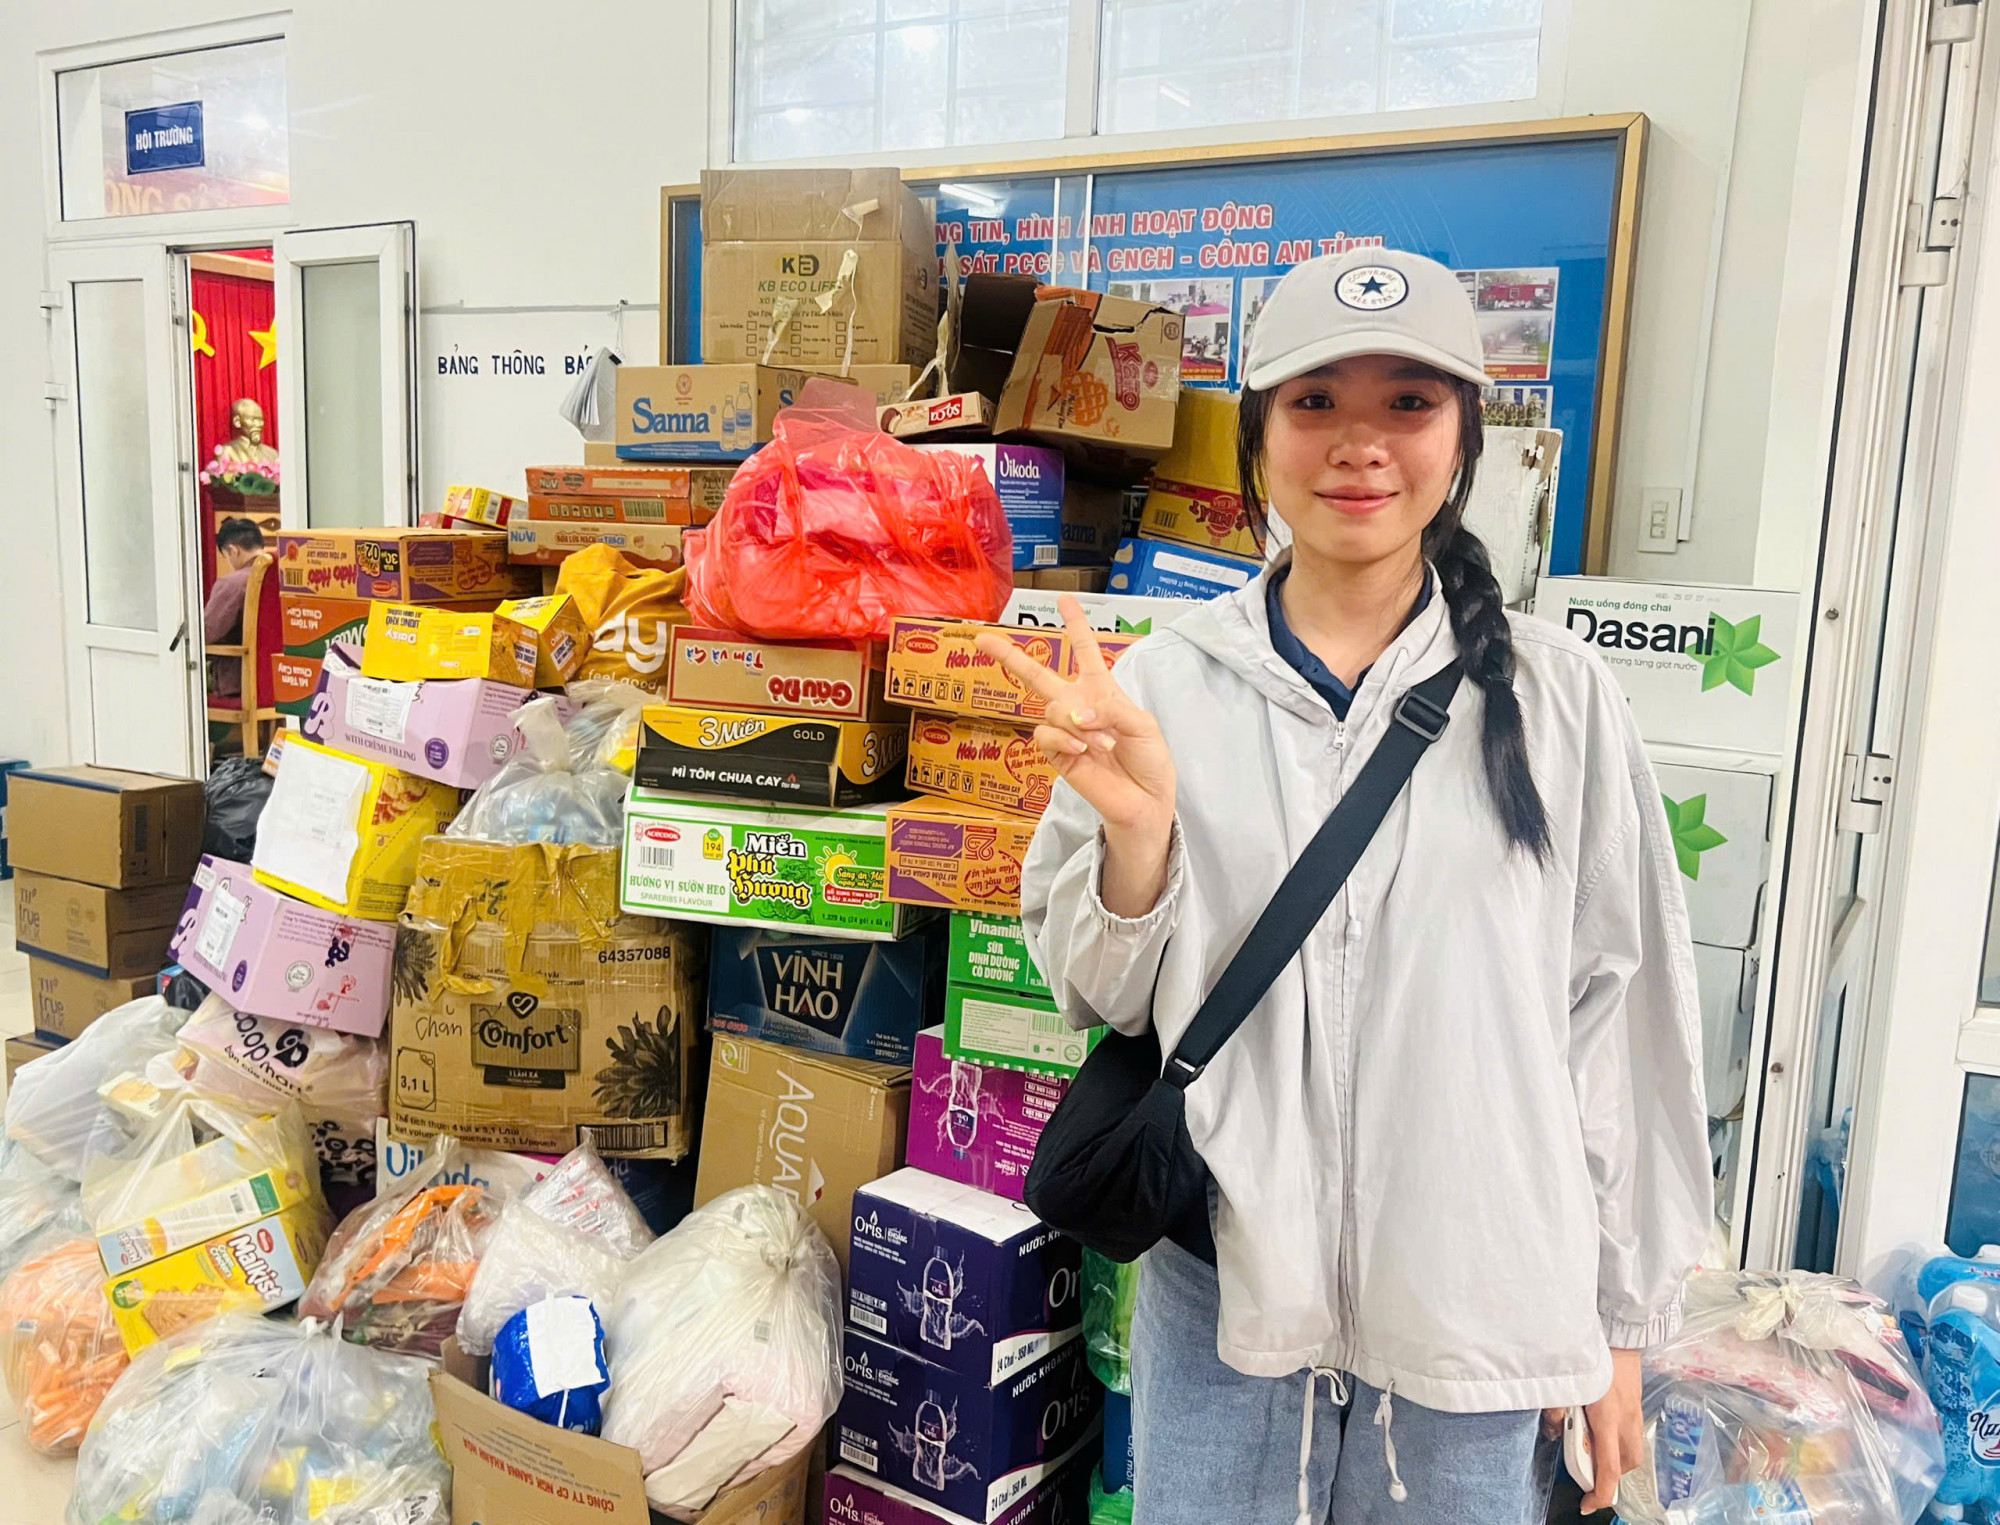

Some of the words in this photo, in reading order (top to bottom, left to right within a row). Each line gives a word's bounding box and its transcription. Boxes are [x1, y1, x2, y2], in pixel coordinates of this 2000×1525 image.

[135, 129, 152, 153] HỘI
[153, 124, 194, 148] TRƯỜNG
[968, 219, 1011, 245] TIN,
[1132, 207, 1196, 239] HOẠT
[1202, 201, 1273, 236] ĐỘNG
[1107, 244, 1174, 272] CNCH
[1199, 238, 1270, 269] CÔNG
[1275, 239, 1312, 265] AN
[758, 280, 777, 293] KB
[780, 280, 806, 292] ECO
[438, 344, 479, 375] BẢNG
[492, 349, 545, 375] THÔNG
[632, 397, 710, 434] Sanna
[1568, 597, 1594, 608] Nước
[1597, 598, 1621, 611] uống
[1623, 600, 1649, 613] đóng
[1650, 601, 1672, 613] chai
[1566, 607, 1716, 656] Dasani
[686, 645, 707, 664] Gà
[712, 648, 728, 665] và
[734, 651, 764, 669] Tôm
[945, 647, 971, 670] Hảo
[793, 730, 826, 741] GOLD
[344, 732, 363, 747] WITH
[363, 736, 387, 755] CRÈME
[388, 743, 416, 762] FILLING
[956, 740, 977, 761] Hảo
[979, 740, 1001, 761] Hảo
[671, 765, 687, 778] MÌ
[689, 766, 716, 782] TÔM
[718, 770, 753, 785] CHUA
[756, 774, 783, 787] CAY
[706, 842, 721, 851] 194
[630, 874, 661, 889] HƯƠNG
[664, 880, 674, 893] VỊ
[678, 880, 704, 893] SƯỜN
[706, 884, 726, 896] HEO
[640, 892, 678, 903] SPARERIBS
[679, 896, 713, 907] FLAVOUR
[970, 919, 1025, 940] Vinamilk
[597, 946, 670, 964] 64357088
[986, 940, 1003, 956] SỮA
[772, 950, 844, 989] VĨNH
[968, 952, 989, 965] DINH
[990, 952, 1020, 971] DƯỠNG
[478, 1019, 569, 1055] Comfort
[401, 1074, 417, 1089] 3,1
[422, 1080, 430, 1093] L
[1019, 1236, 1046, 1257] NƯỚC
[227, 1233, 283, 1301] Malkist
[1012, 1372, 1038, 1398] NƯỚC
[508, 1466, 535, 1488] SANNA
[556, 1487, 569, 1500] CP
[571, 1491, 585, 1505] TY
[587, 1494, 615, 1514] CÔNG
